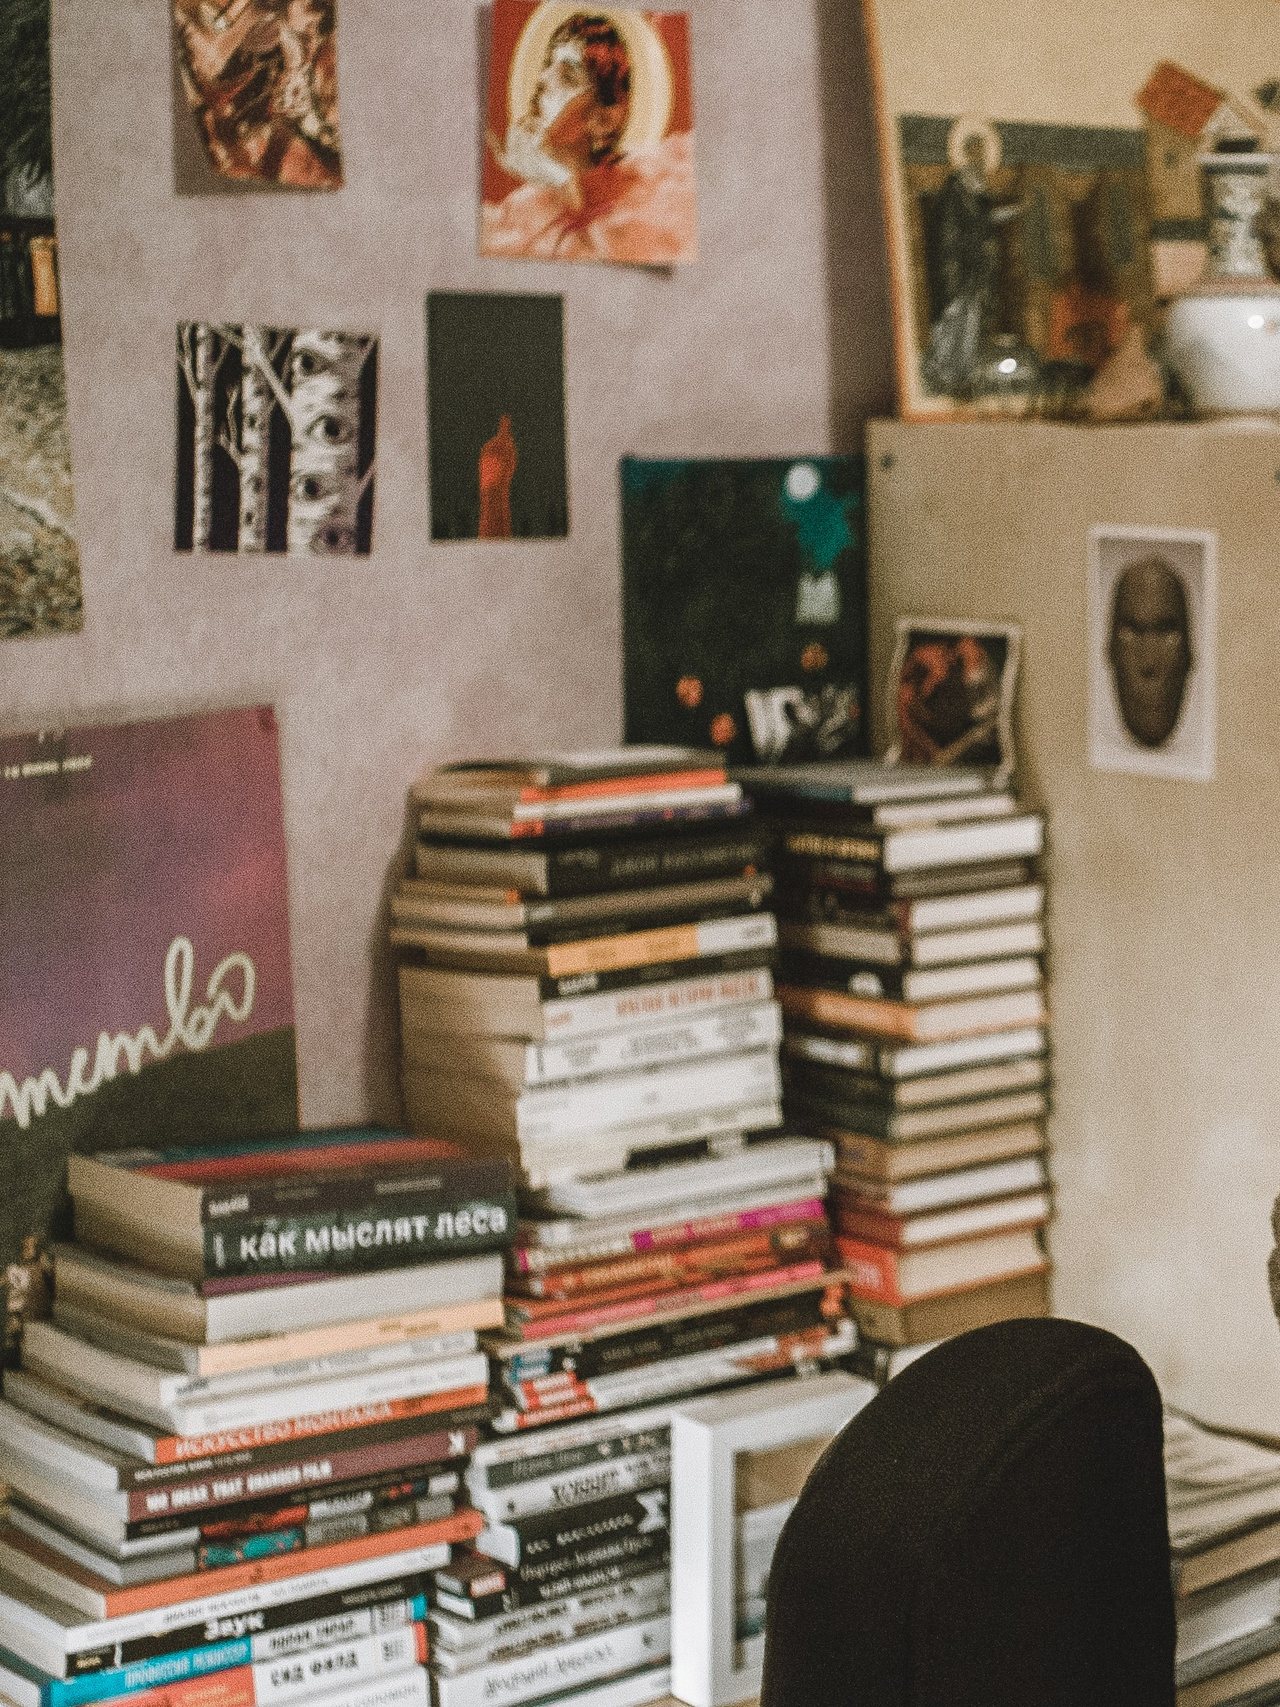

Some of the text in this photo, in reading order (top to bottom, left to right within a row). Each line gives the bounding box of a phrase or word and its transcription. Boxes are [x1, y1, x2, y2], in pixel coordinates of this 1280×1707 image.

[239, 1205, 507, 1262] как мыслят леса
